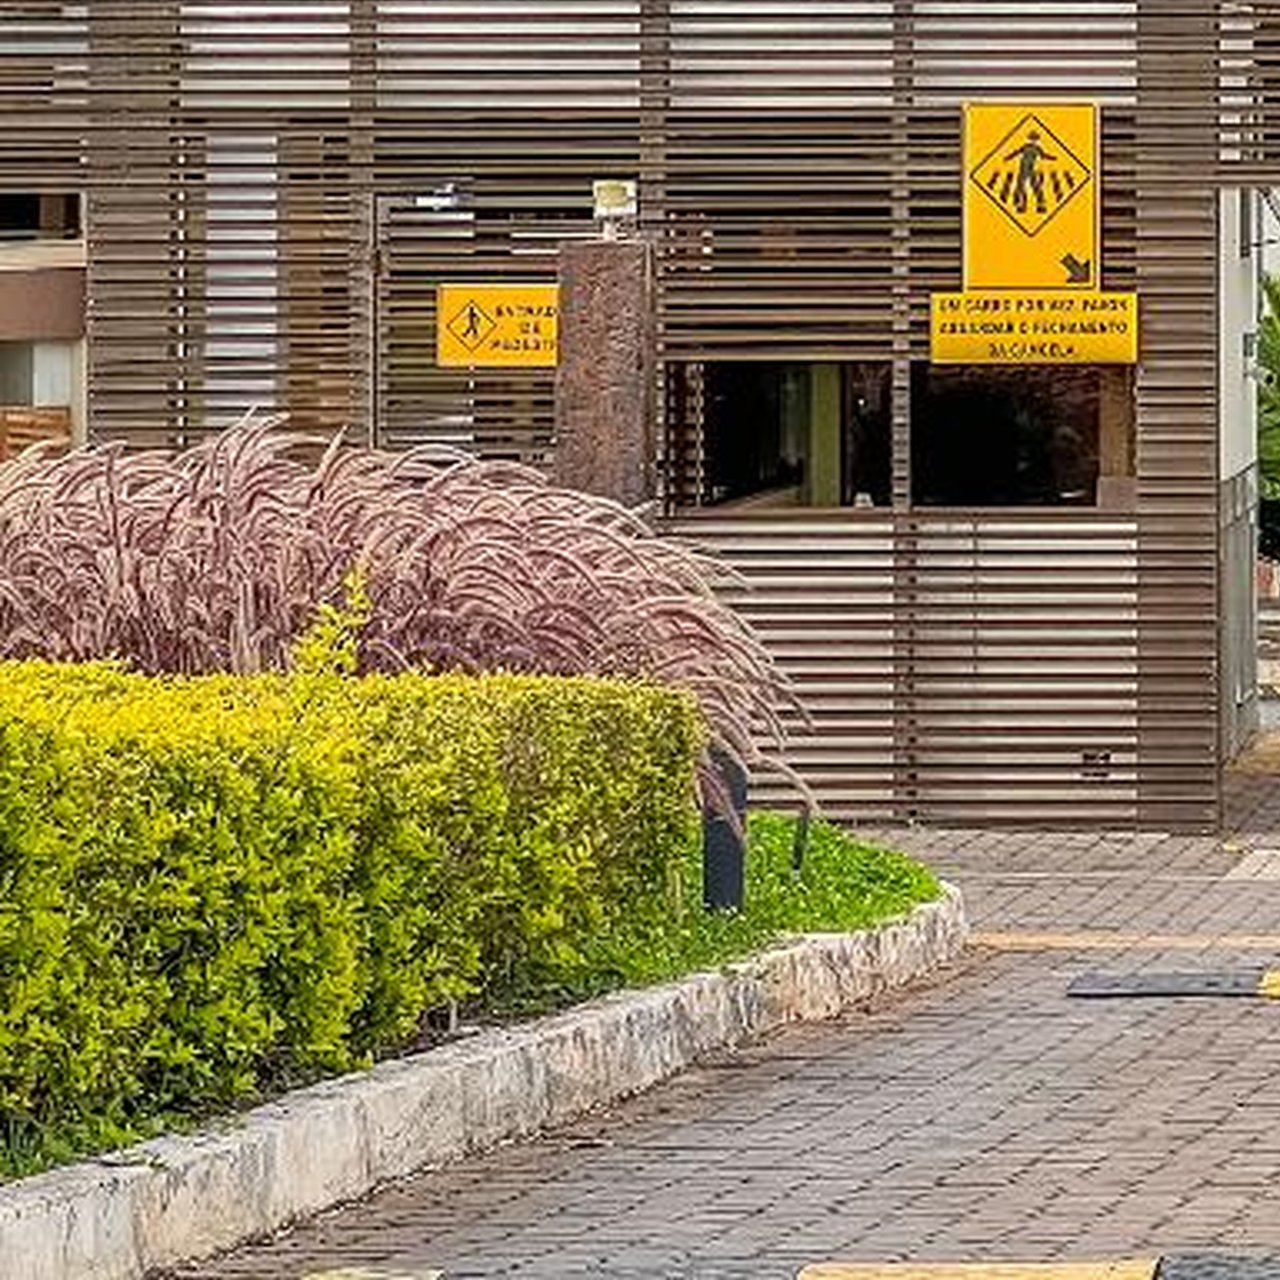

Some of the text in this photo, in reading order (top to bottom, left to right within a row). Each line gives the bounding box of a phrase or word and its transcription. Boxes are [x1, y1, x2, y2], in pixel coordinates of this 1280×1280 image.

[494, 305, 557, 318] ENTRAD
[1032, 321, 1128, 335] FECHAMENTO
[1009, 342, 1074, 358] CANCELA
